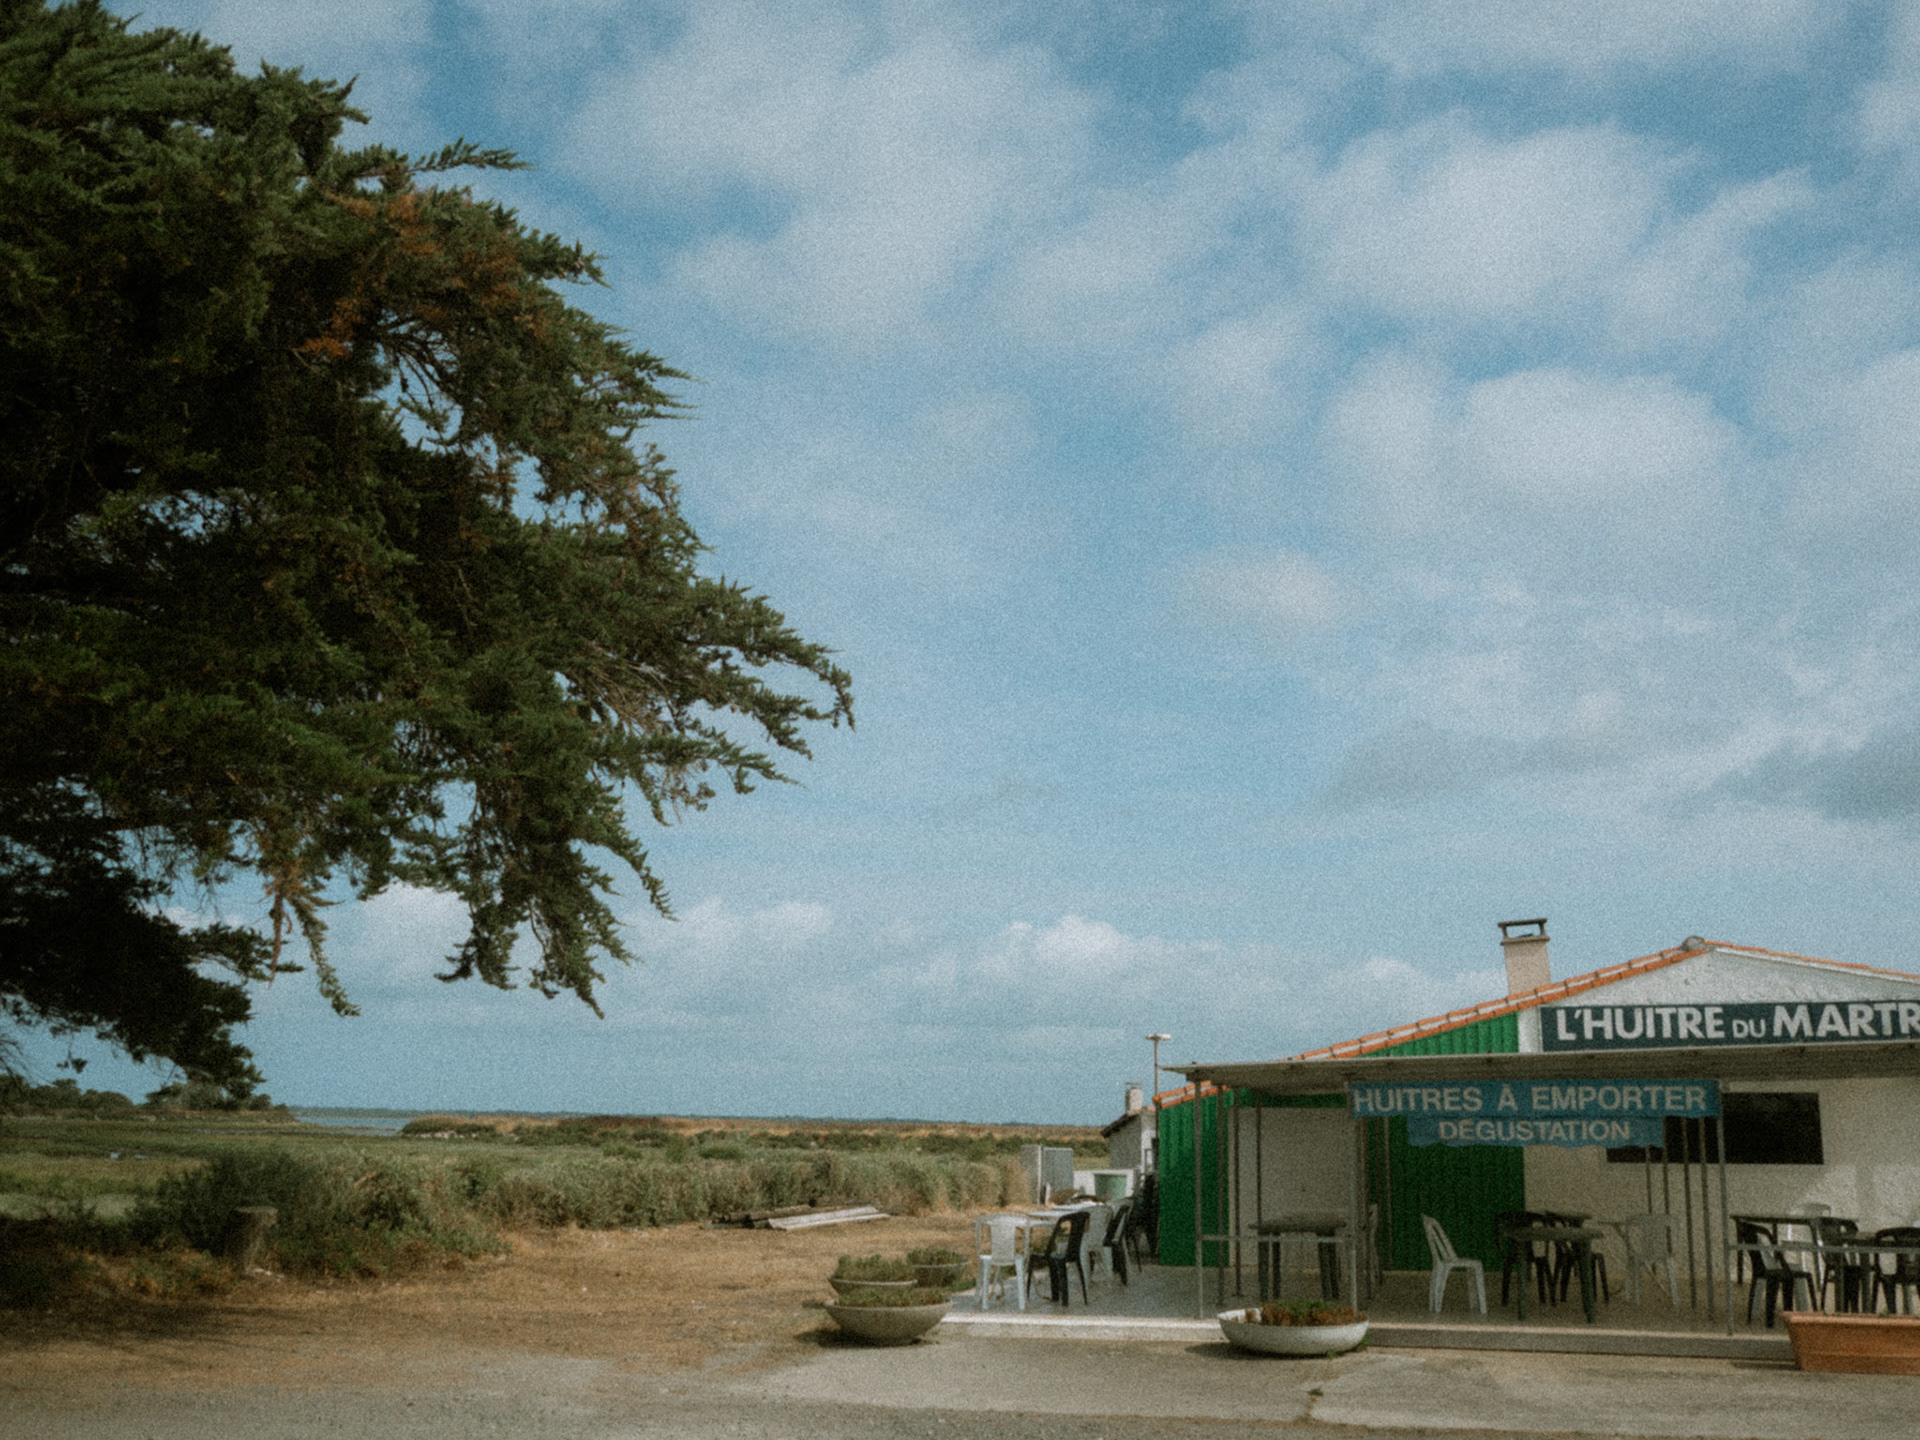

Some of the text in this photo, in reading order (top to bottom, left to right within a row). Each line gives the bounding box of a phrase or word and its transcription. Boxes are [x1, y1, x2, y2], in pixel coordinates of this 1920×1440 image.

[1557, 1006, 1725, 1041] L'HUITRE
[1732, 1019, 1766, 1038] DU
[1353, 1086, 1483, 1113] HUITRES
[1531, 1085, 1706, 1111] EMPORTER
